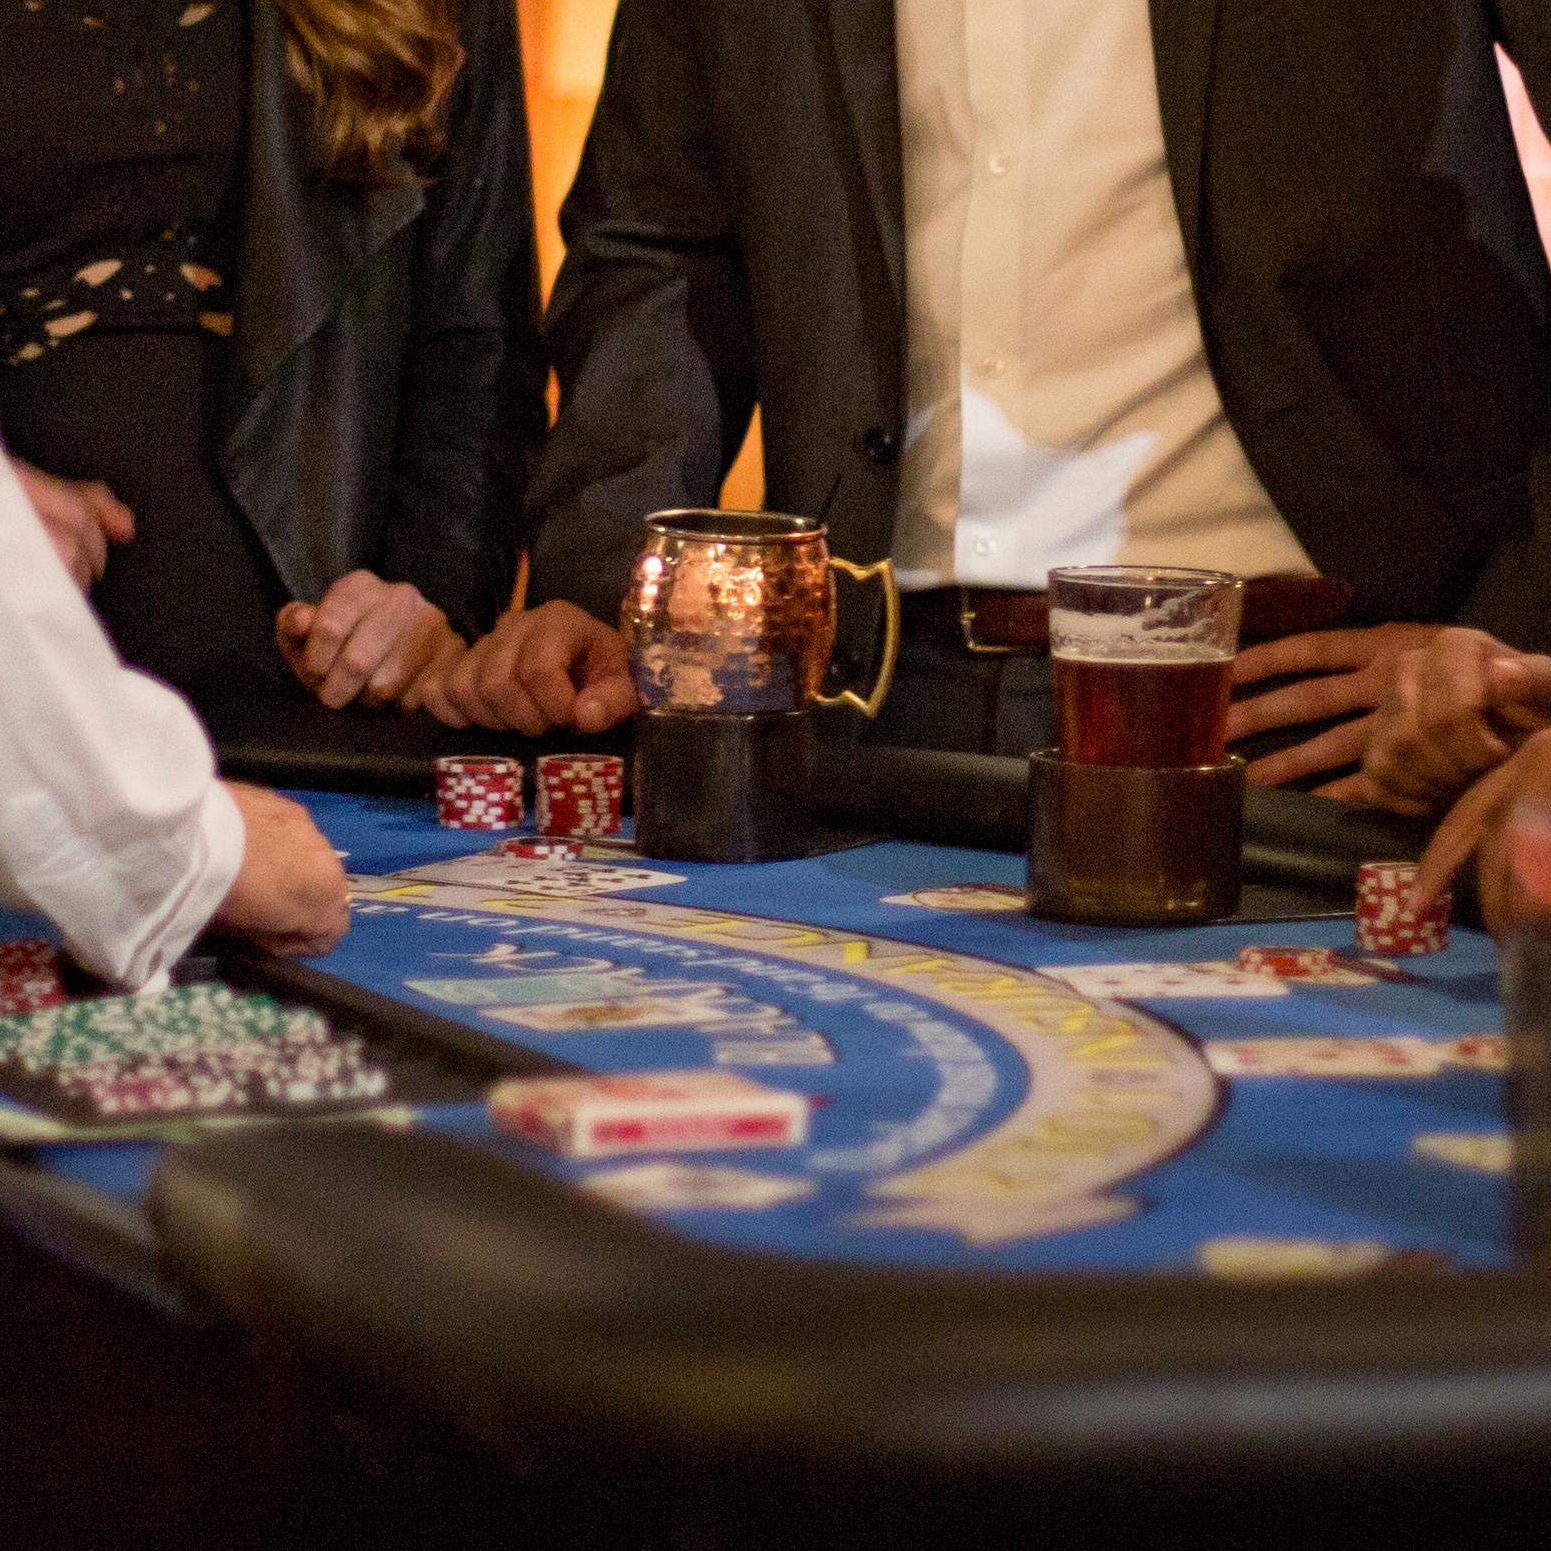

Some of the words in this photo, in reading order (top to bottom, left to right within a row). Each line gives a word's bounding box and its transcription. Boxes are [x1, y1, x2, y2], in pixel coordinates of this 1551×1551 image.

[419, 911, 518, 928] on
[503, 925, 716, 960] stand
[637, 909, 1177, 1069] INSURANCE
